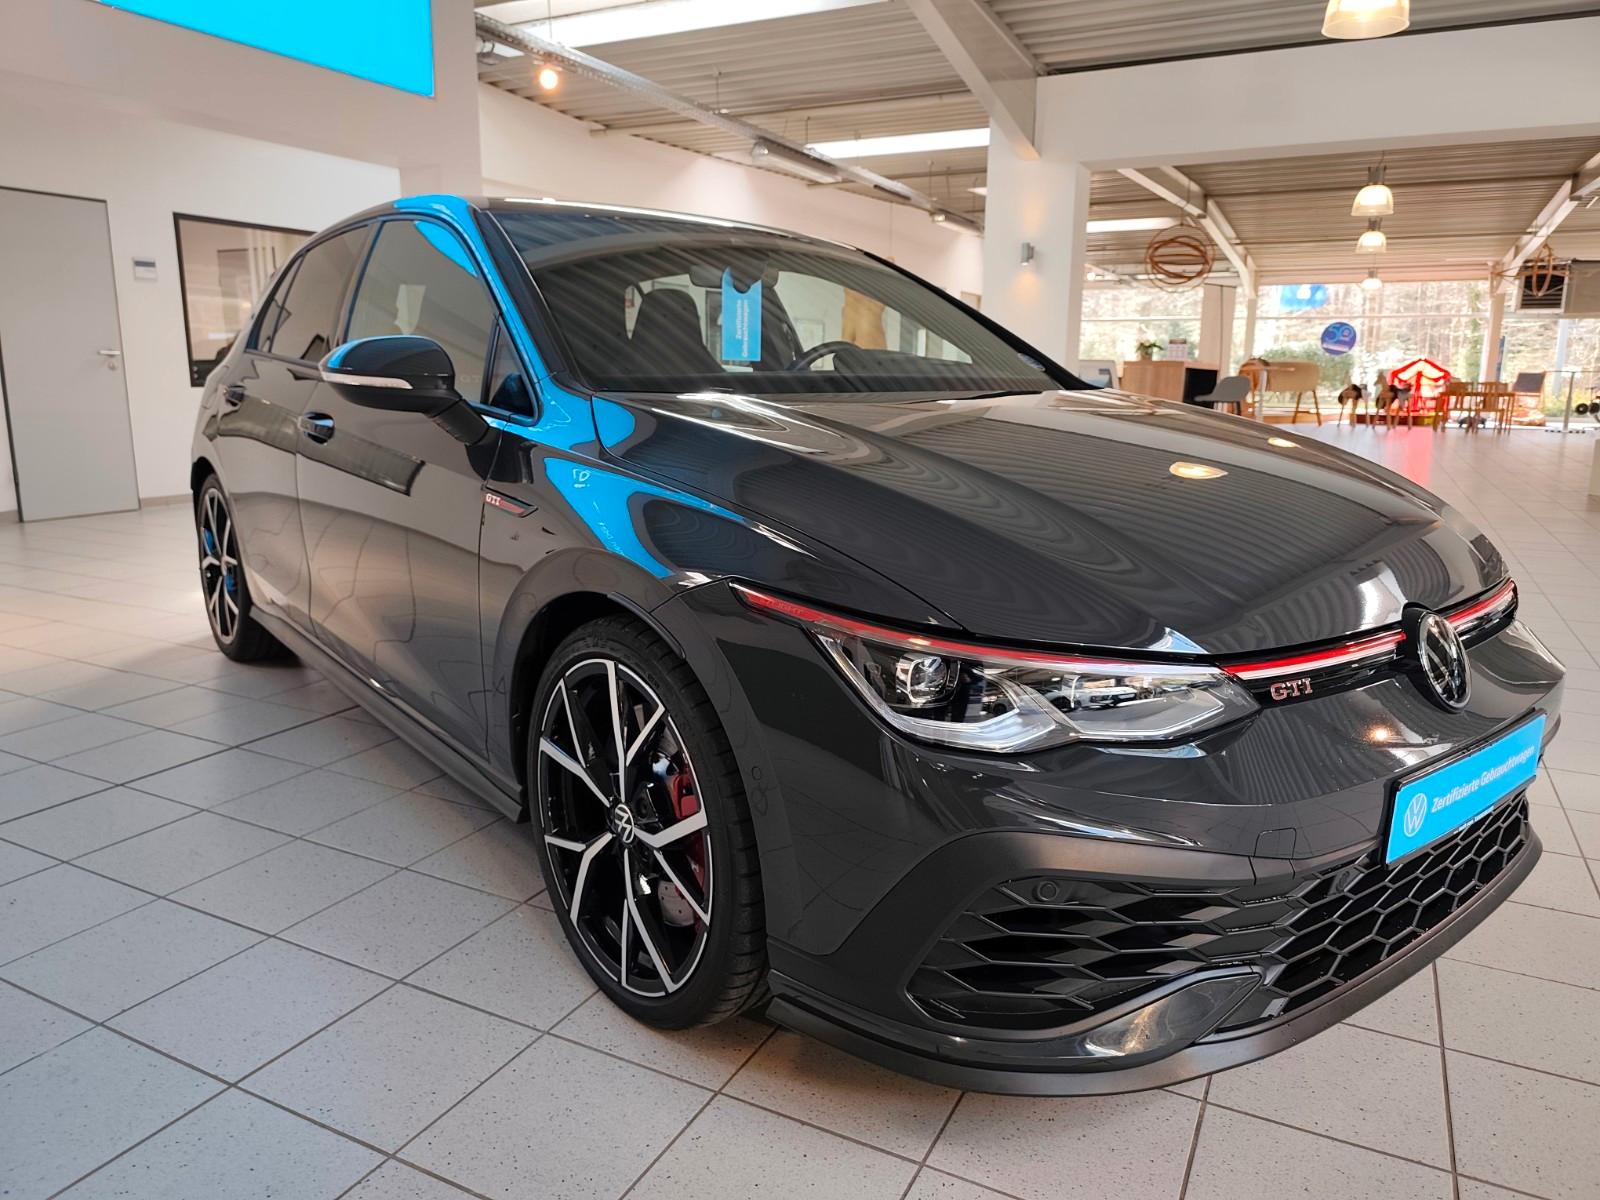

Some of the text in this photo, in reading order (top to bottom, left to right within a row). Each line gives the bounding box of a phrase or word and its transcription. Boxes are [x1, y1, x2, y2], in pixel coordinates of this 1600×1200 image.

[485, 493, 502, 506] GTI
[1270, 677, 1313, 701] GTI
[1432, 778, 1480, 814] Zertifizierte
[1480, 746, 1535, 786] Gebrauchtwagen
